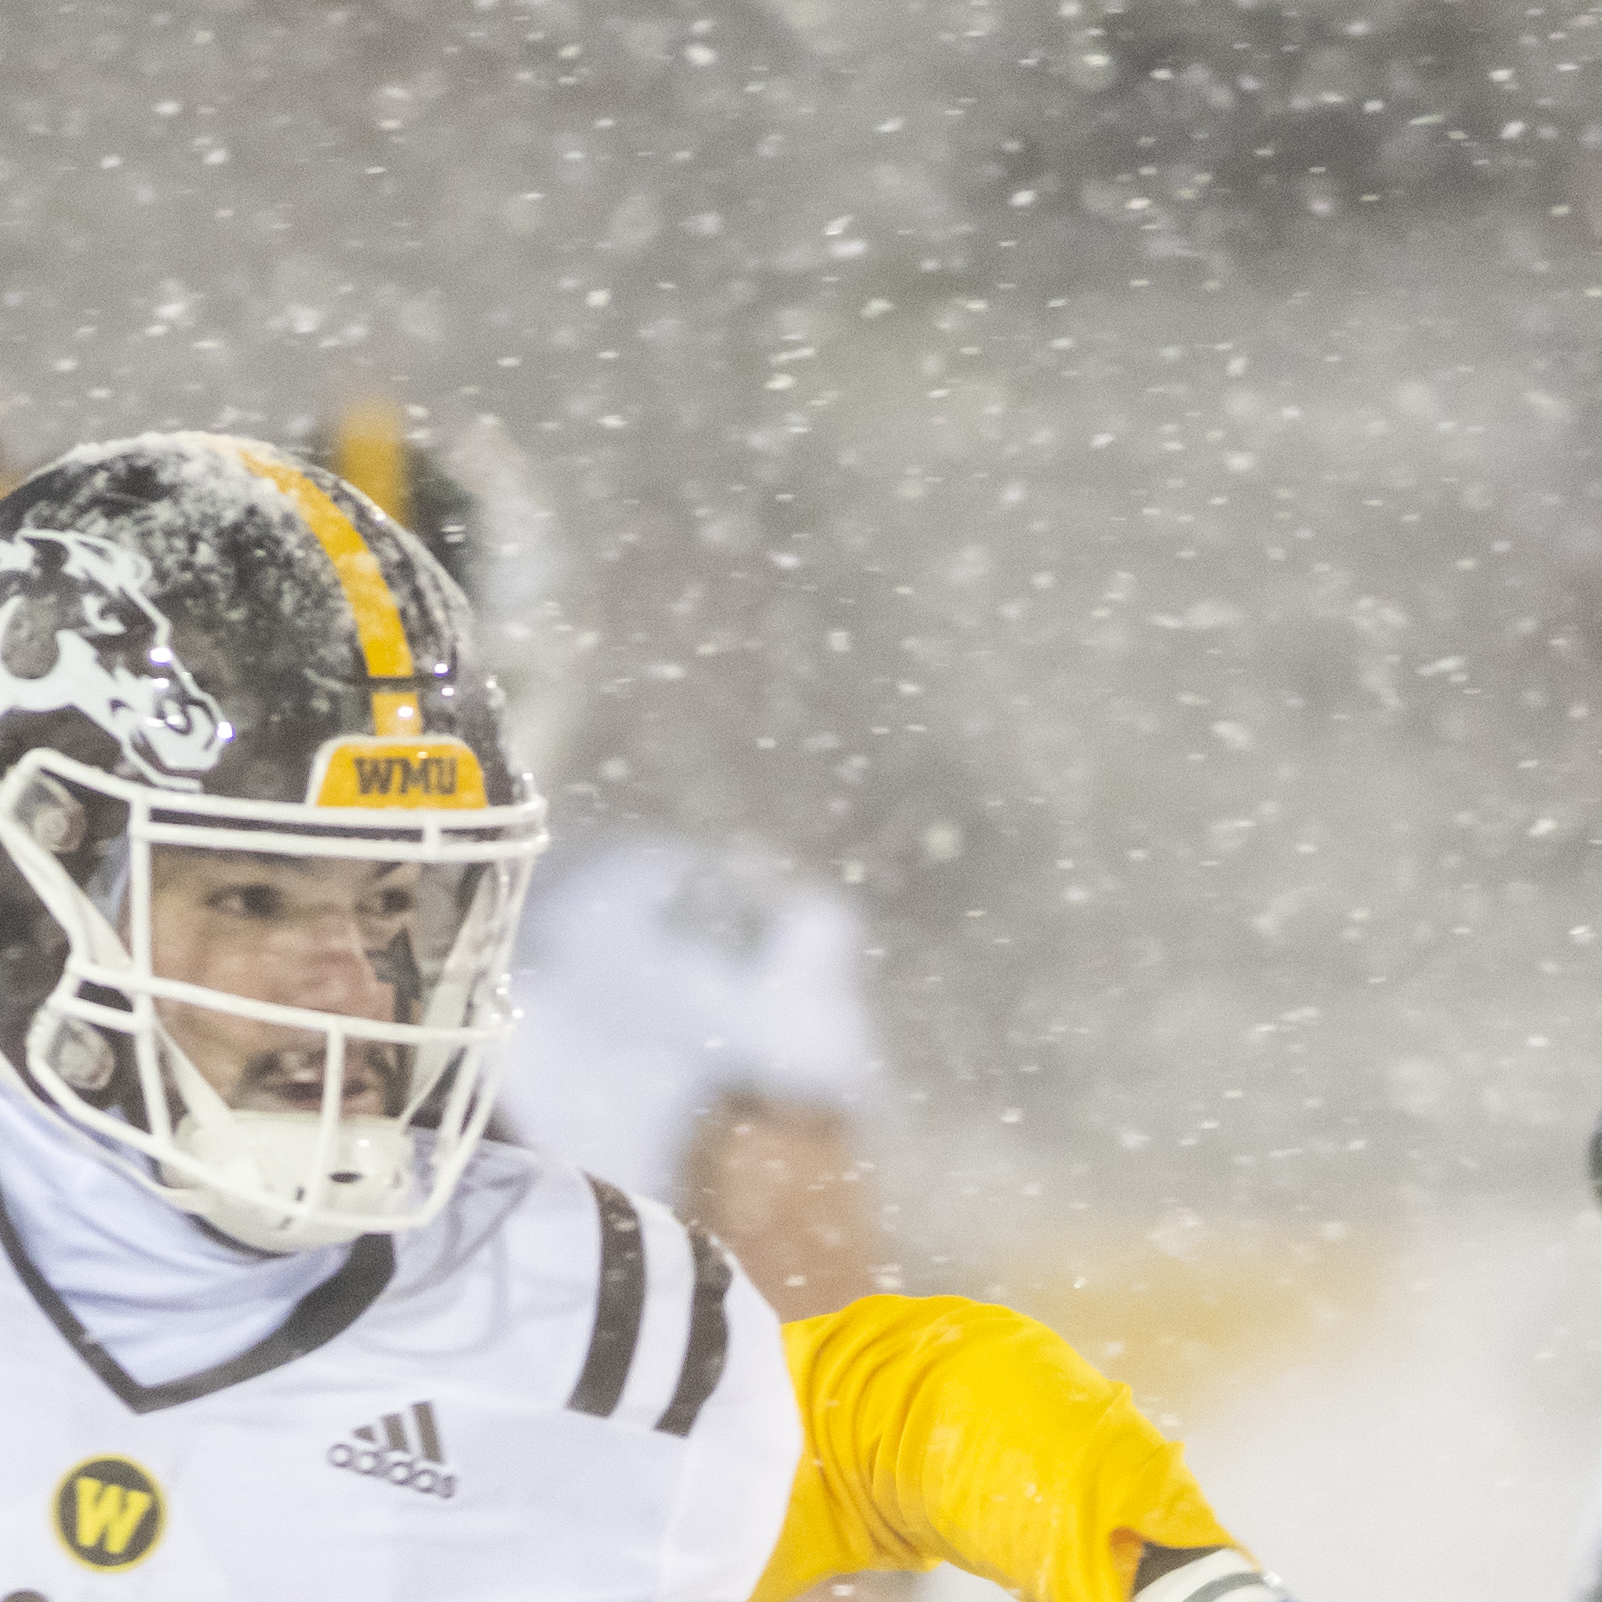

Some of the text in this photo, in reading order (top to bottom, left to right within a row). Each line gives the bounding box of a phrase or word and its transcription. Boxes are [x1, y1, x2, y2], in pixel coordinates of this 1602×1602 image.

[353, 756, 458, 796] WMU
[327, 1443, 459, 1500] adidas
[72, 1475, 155, 1555] W
